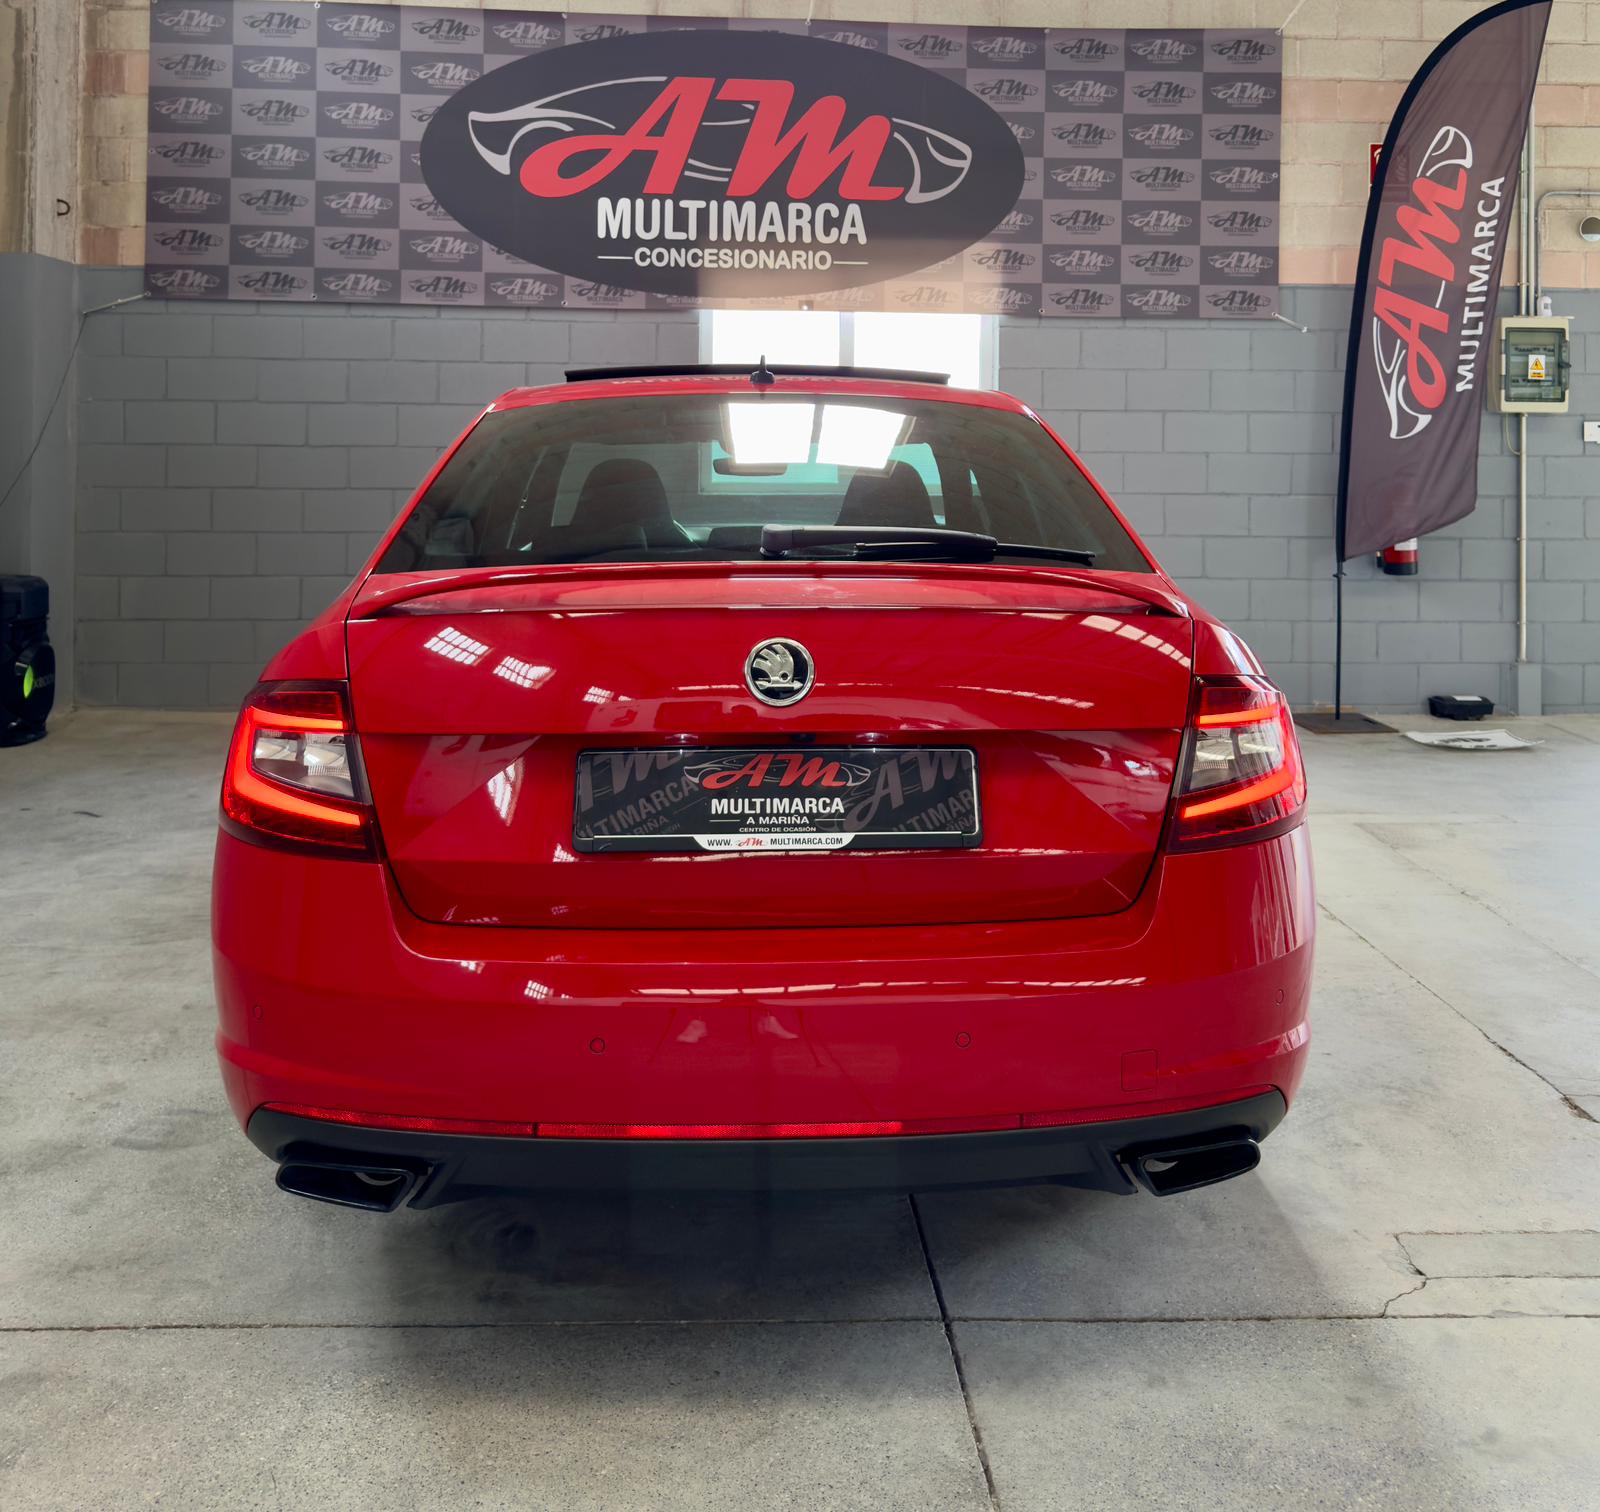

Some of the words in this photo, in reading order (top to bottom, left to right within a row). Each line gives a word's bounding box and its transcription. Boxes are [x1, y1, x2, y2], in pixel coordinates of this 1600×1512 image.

[519, 76, 905, 199] AM
[597, 196, 867, 244] MULTIMARCA
[634, 247, 832, 271] CONCESIONARIO
[1373, 168, 1468, 409] AM
[1455, 176, 1505, 392] MULTIMARCA
[702, 753, 848, 790] AM
[711, 797, 845, 815] MULTIMARCA
[746, 816, 756, 825] A
[758, 815, 809, 825] MARIÑA
[707, 839, 732, 847] WWW.
[770, 837, 843, 846] MULTIMARCA.COM
